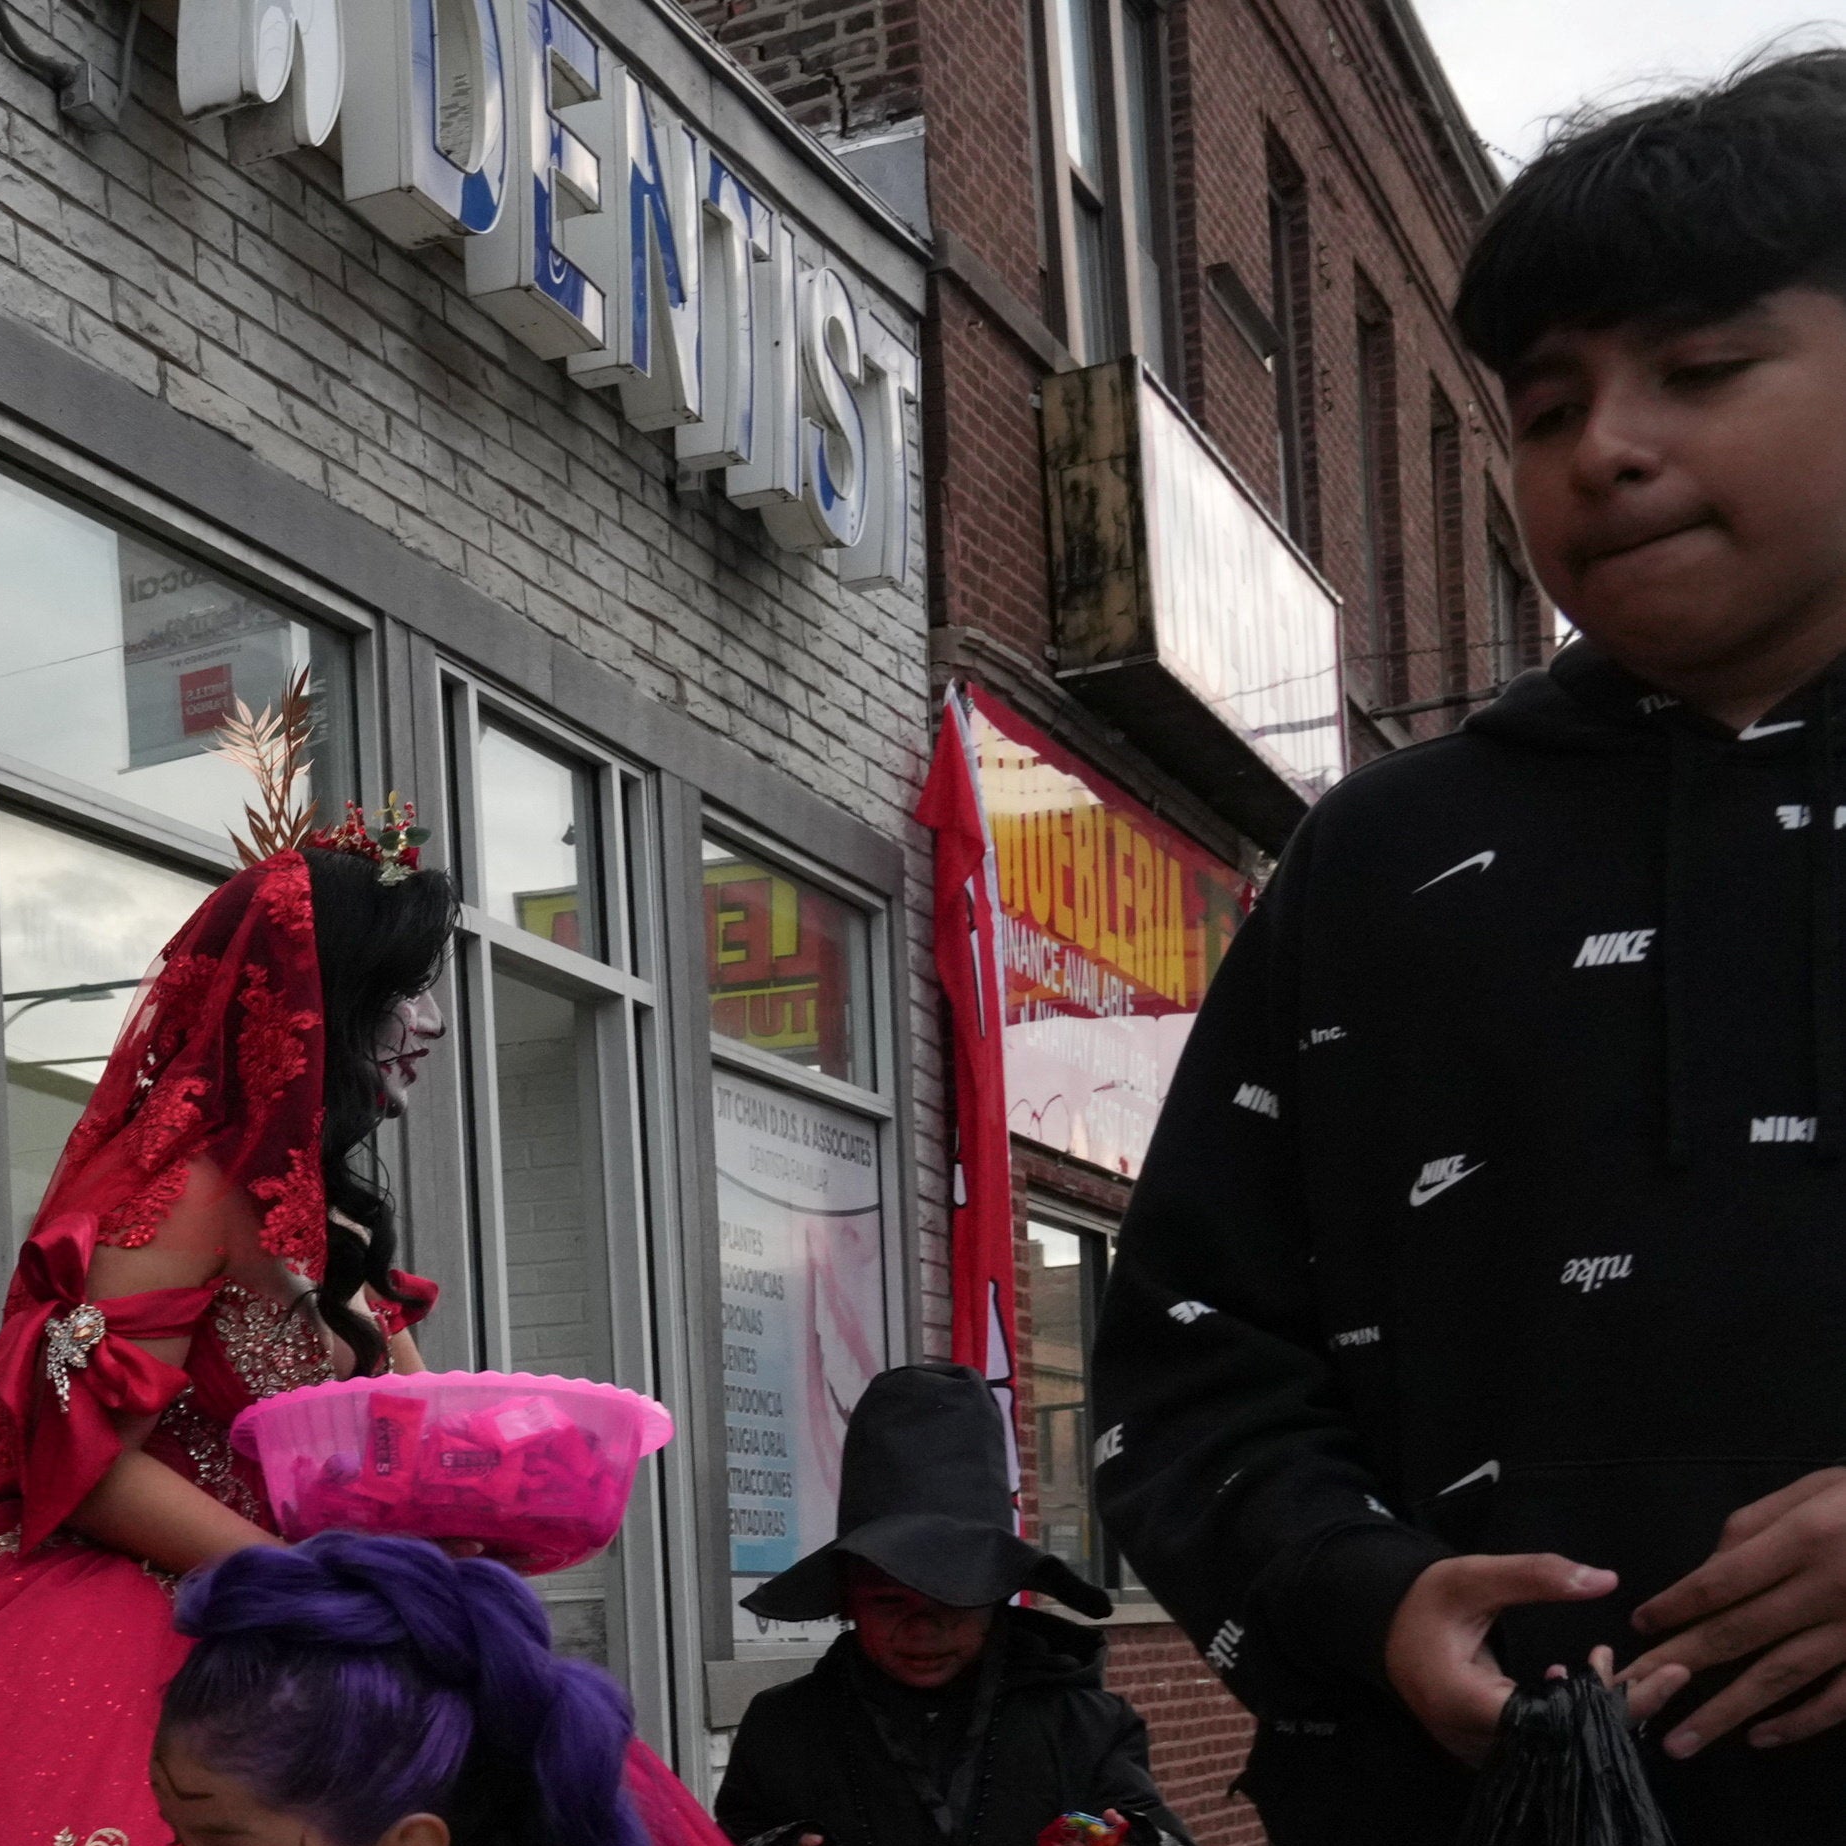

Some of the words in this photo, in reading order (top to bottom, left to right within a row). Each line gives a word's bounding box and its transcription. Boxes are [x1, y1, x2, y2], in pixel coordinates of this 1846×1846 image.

[402, 0, 920, 590] DENTIST
[1001, 910, 1061, 993] INANCE
[1573, 928, 1656, 968] NIKE
[1418, 1153, 1468, 1186] NIKE
[1561, 1254, 1634, 1293] nike
[724, 1384, 785, 1419] RTODONCIA
[729, 1507, 787, 1538] ENTADURAS
[1206, 1618, 1246, 1670] nik
